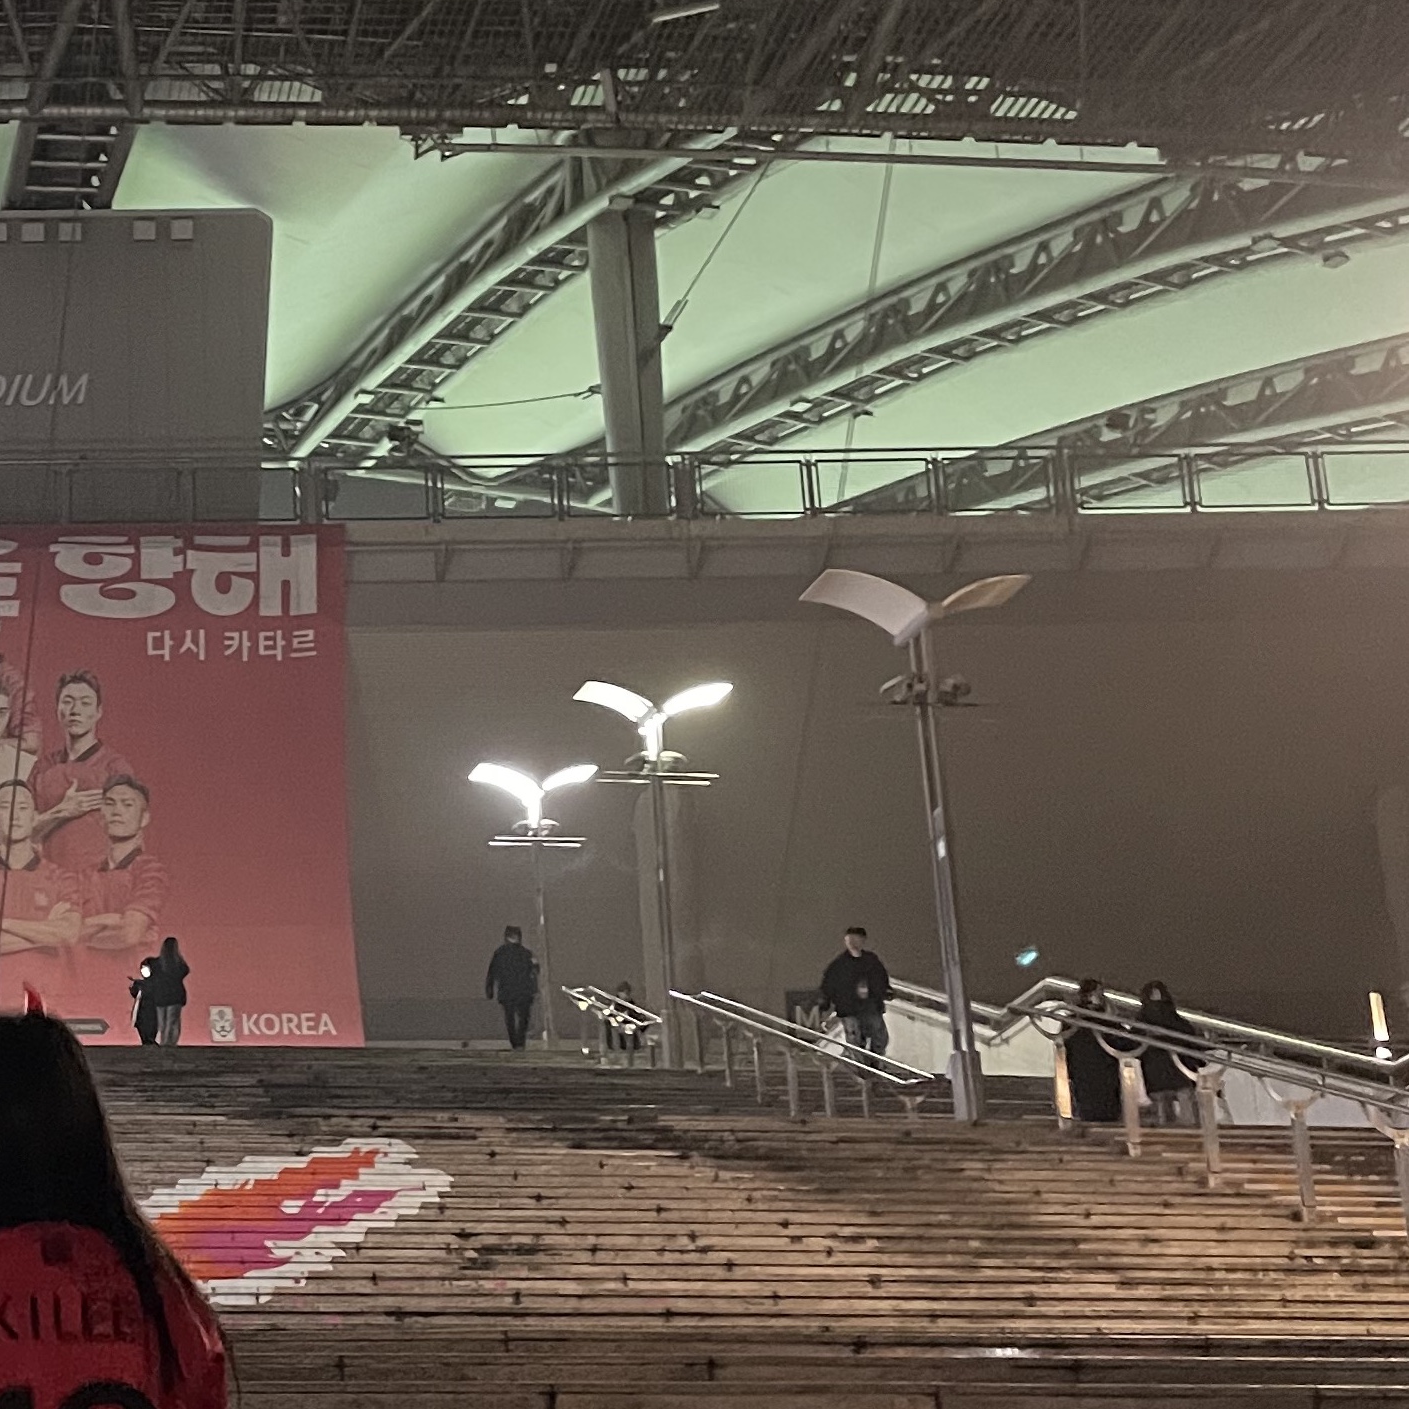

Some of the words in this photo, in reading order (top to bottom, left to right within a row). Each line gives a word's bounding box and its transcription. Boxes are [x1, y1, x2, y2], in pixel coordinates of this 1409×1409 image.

[48, 533, 318, 619] 향해
[146, 628, 206, 661] 다시
[223, 628, 318, 662] 카타르
[241, 1012, 338, 1036] KOREA
